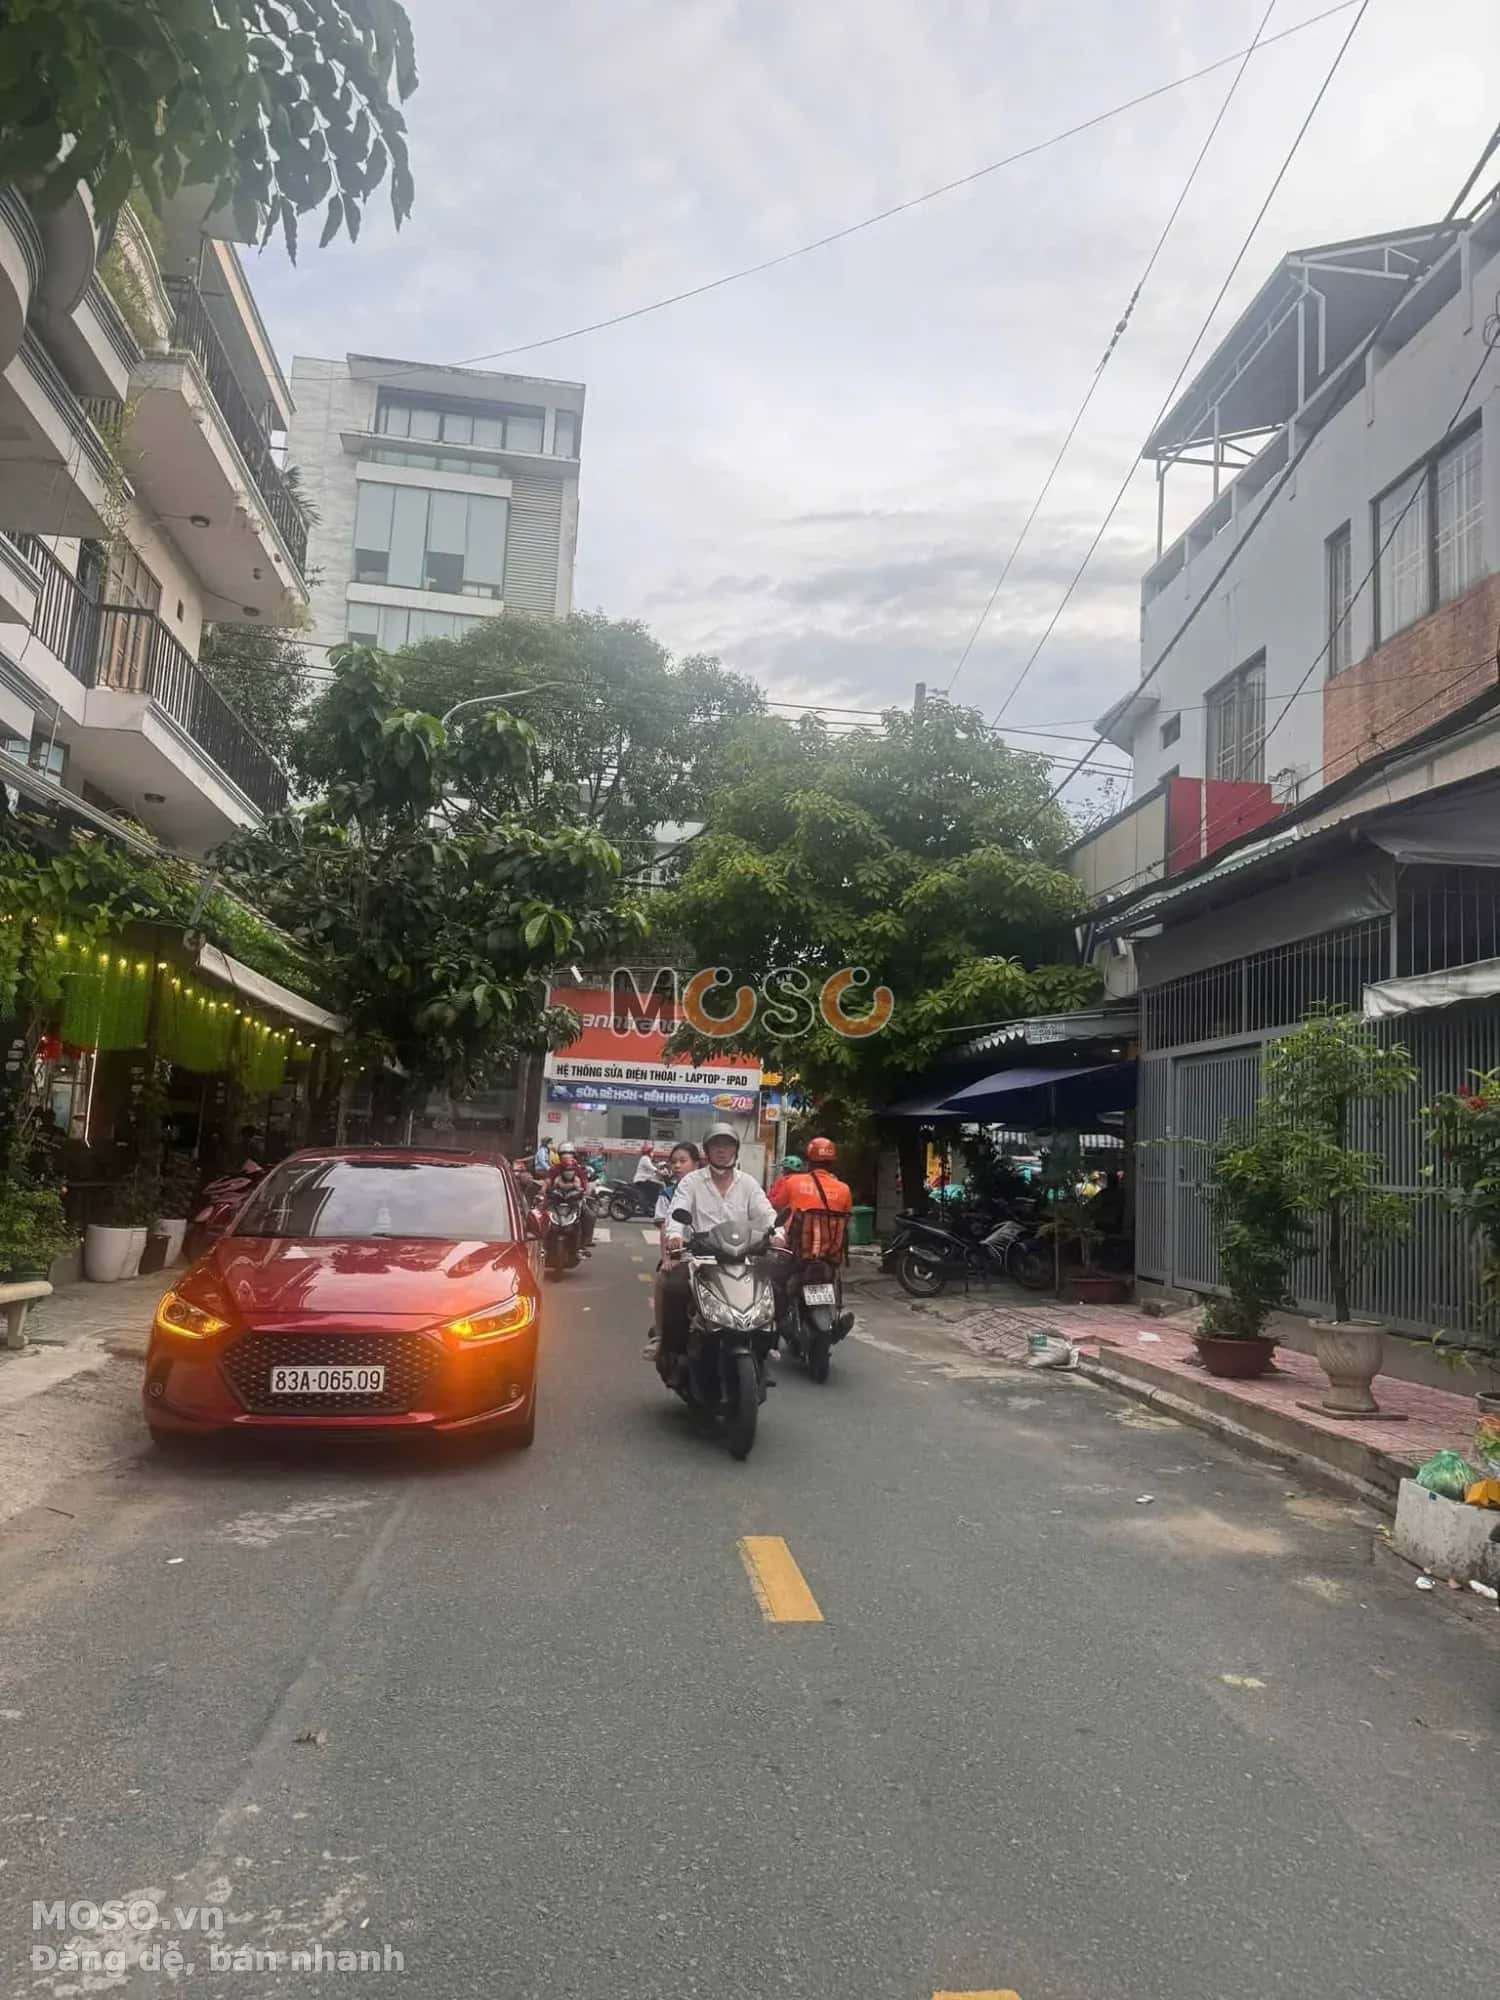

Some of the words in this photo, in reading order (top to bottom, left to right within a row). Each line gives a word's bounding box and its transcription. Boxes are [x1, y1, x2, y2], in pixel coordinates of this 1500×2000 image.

[556, 1063, 569, 1078] HỆ
[571, 1063, 602, 1077] THỐNG
[604, 1063, 623, 1079] SỬA
[625, 1066, 648, 1082] ĐIỆN
[650, 1070, 677, 1084] THOẠI
[685, 1072, 720, 1084] LAPTOP
[726, 1075, 748, 1086] IPAD
[275, 1370, 381, 1391] 83A-065.09
